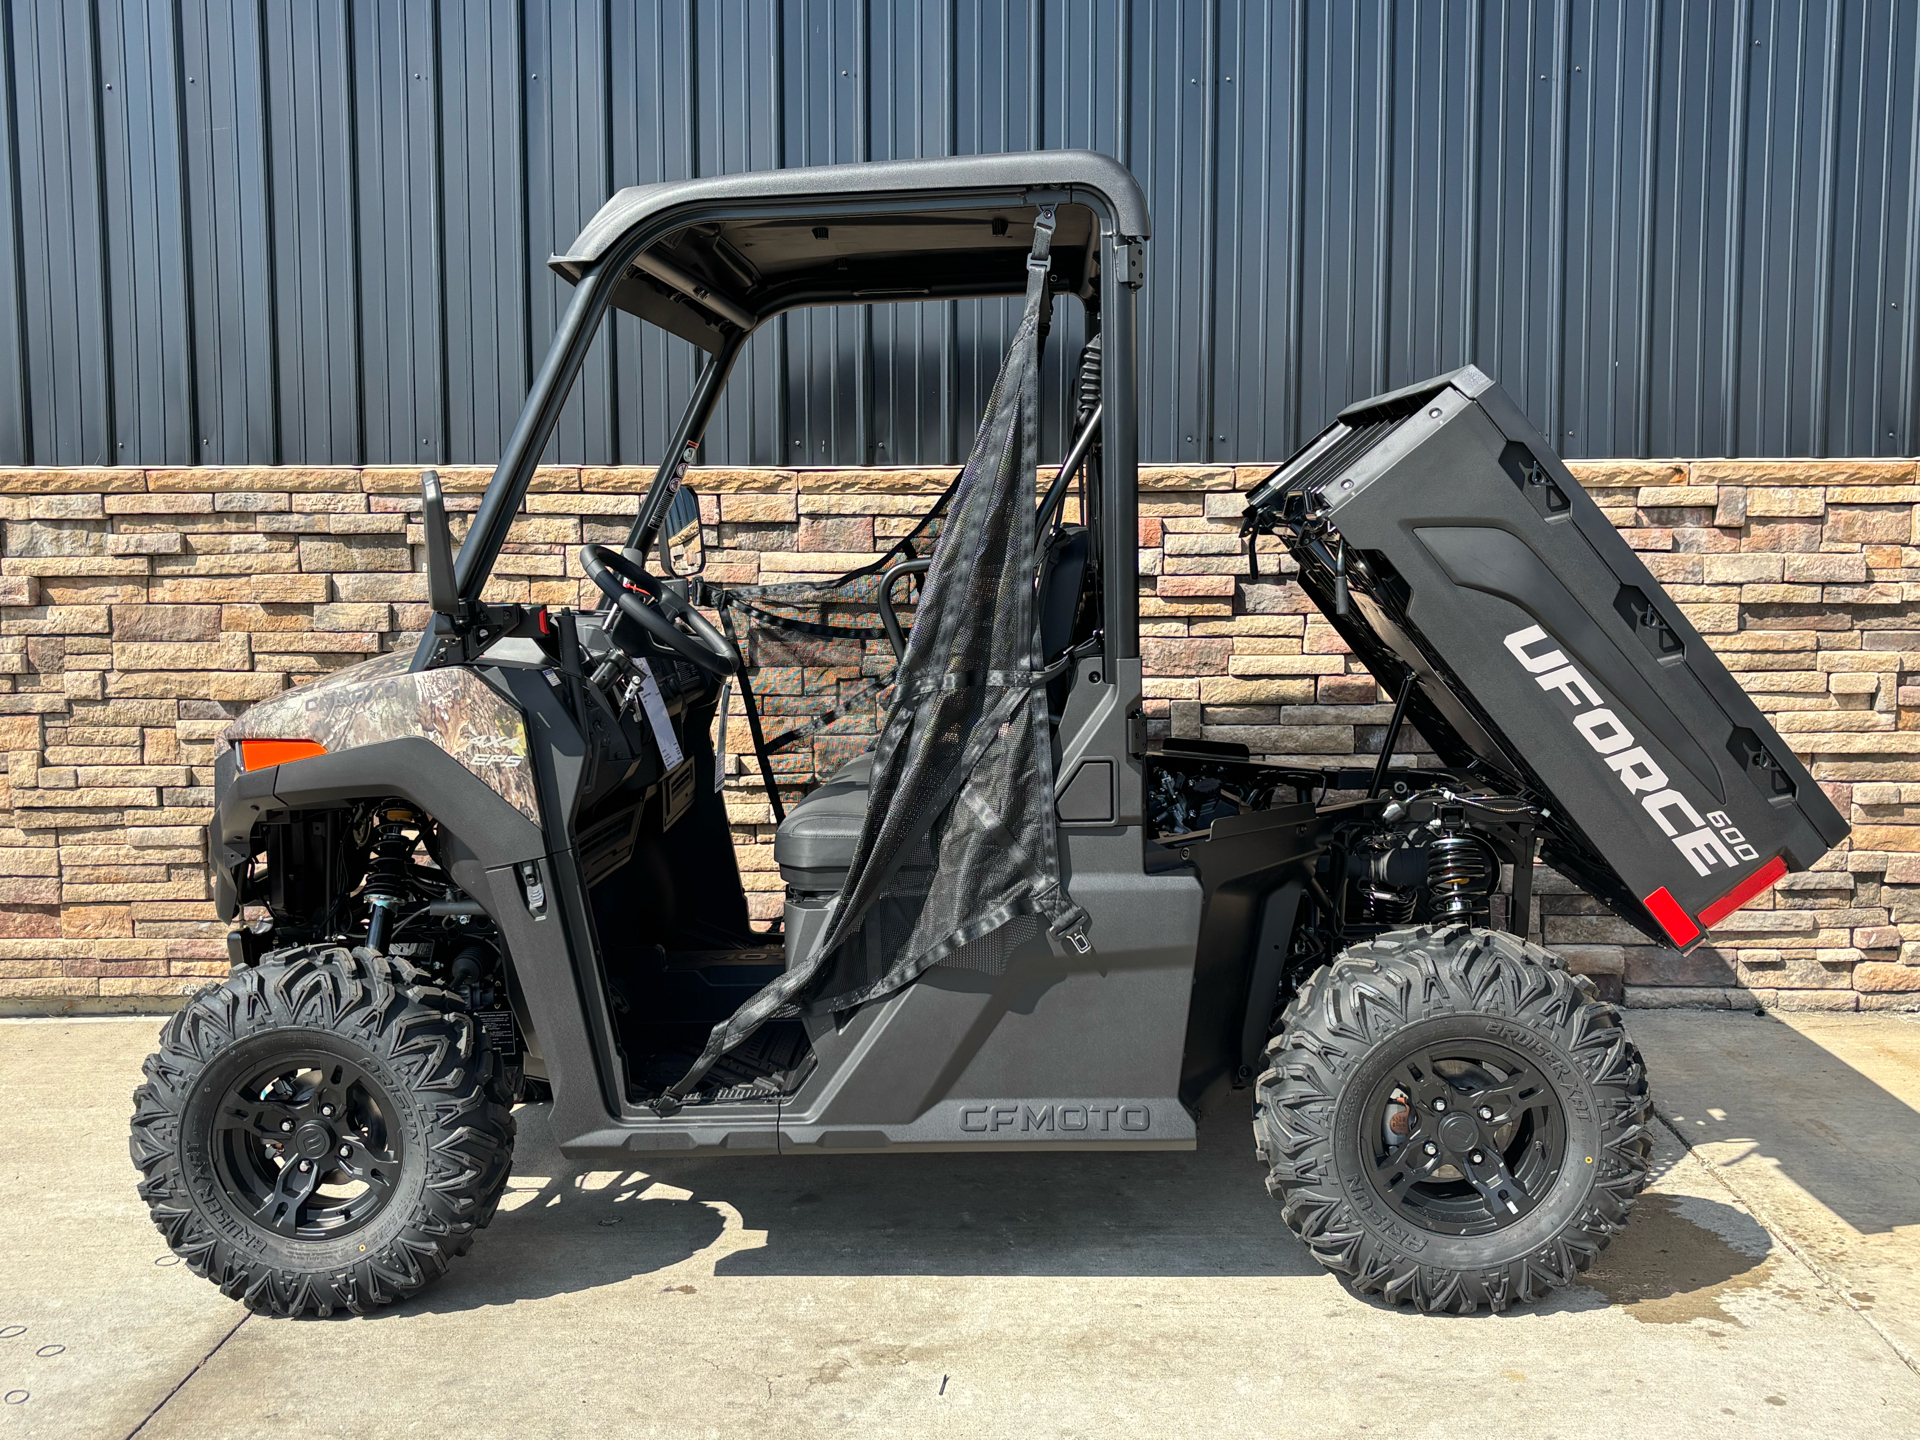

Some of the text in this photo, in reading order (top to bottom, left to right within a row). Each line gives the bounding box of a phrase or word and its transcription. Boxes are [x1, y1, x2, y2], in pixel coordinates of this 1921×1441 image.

[468, 735, 521, 749] 4X4
[470, 753, 525, 767] EPS
[1503, 624, 1740, 878] UFORCE
[1706, 810, 1760, 861] 600
[1485, 1021, 1571, 1081] BRUISER
[959, 1105, 1150, 1131] CFMOTO
[196, 1183, 269, 1254] BRUISER
[1345, 1173, 1429, 1253] ARISUN
